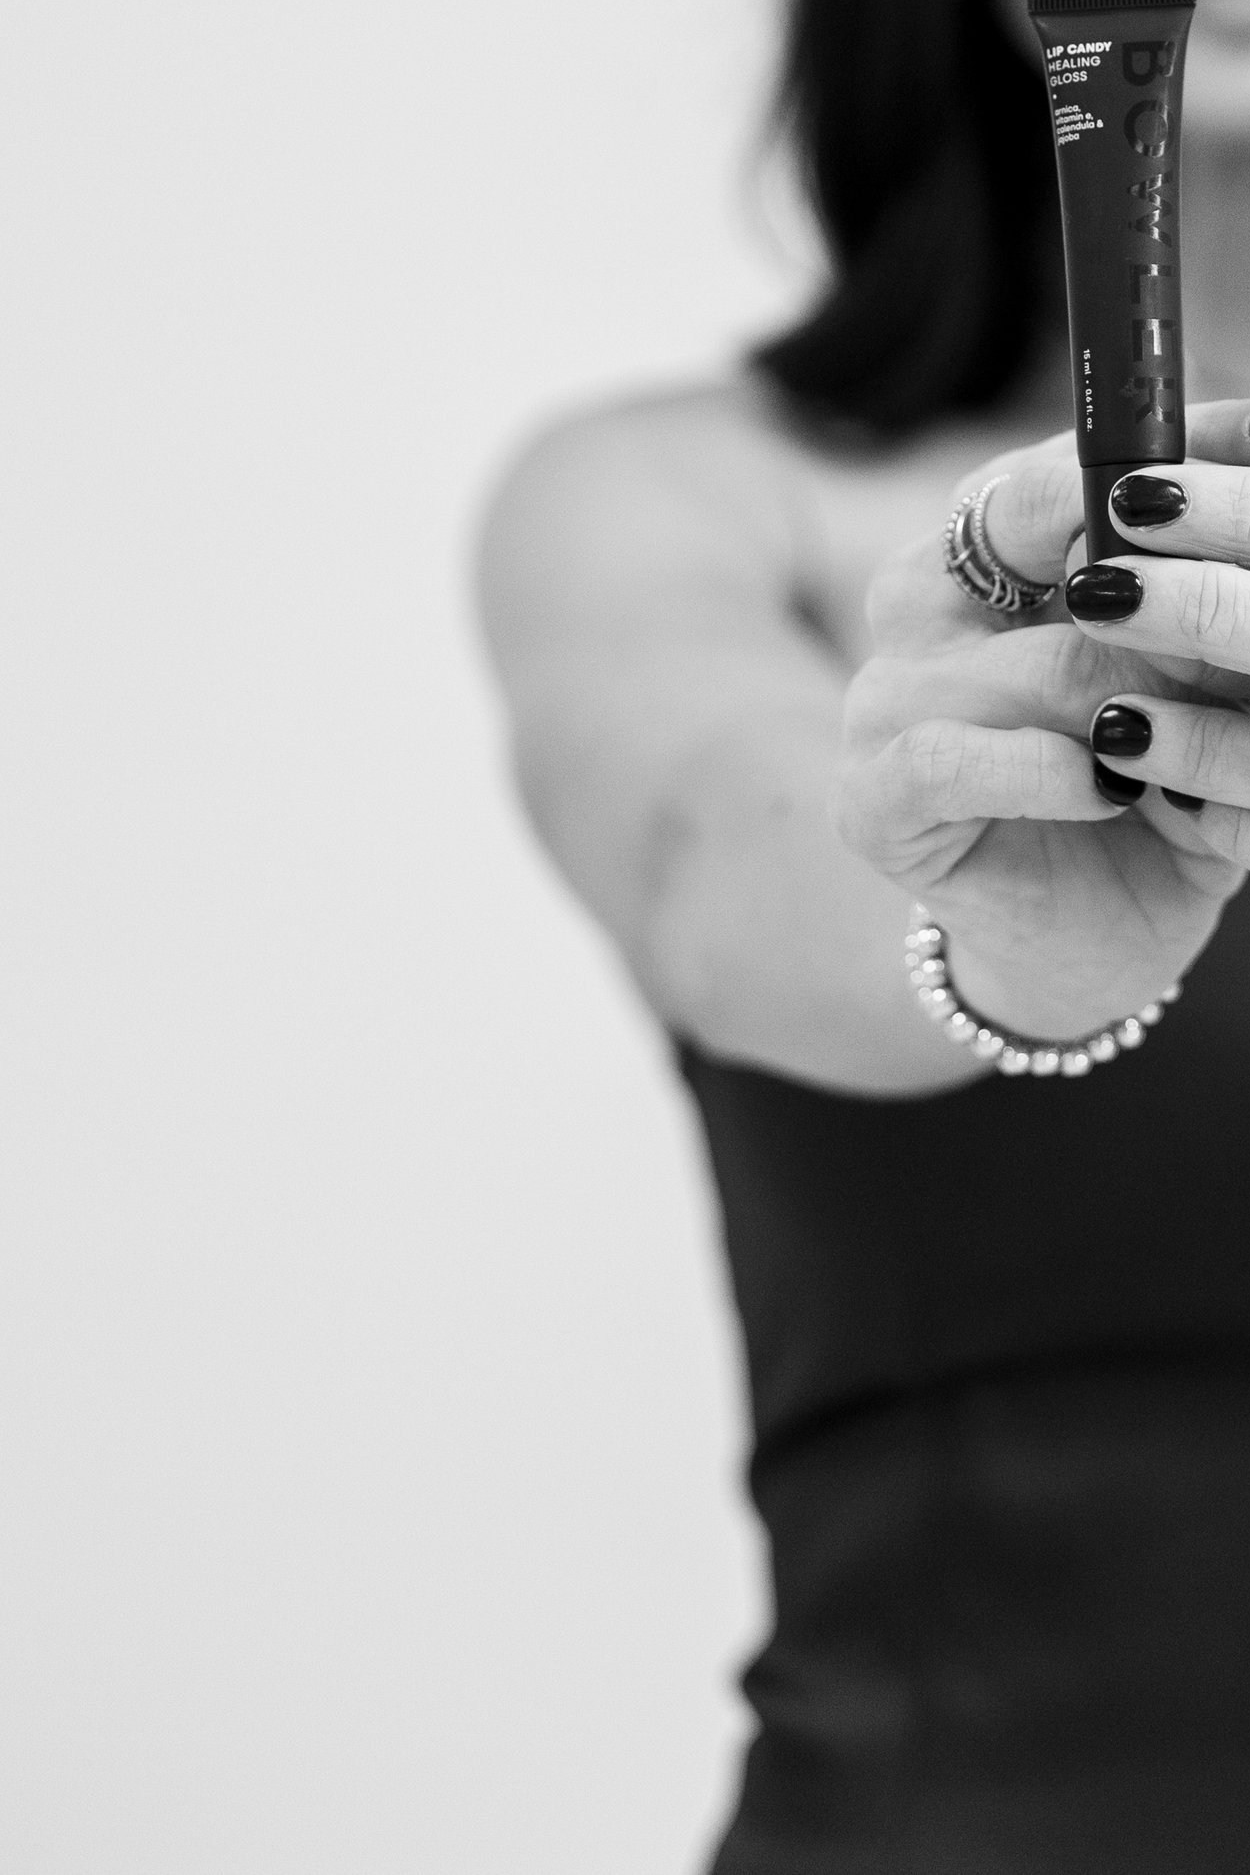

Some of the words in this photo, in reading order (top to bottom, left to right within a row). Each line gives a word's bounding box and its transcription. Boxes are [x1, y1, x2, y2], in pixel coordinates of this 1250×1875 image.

[1046, 45, 1064, 59] LIP
[1067, 41, 1112, 55] CANDY
[1048, 55, 1101, 73] HEALING
[1049, 70, 1088, 87] GLOSS
[1054, 104, 1081, 116] arnica,
[1056, 113, 1083, 125] vitamin
[1056, 120, 1095, 135] calendula
[1096, 119, 1104, 128] &
[1122, 40, 1178, 424] BOWLER
[1082, 348, 1091, 360] 15
[1083, 362, 1092, 375] ml
